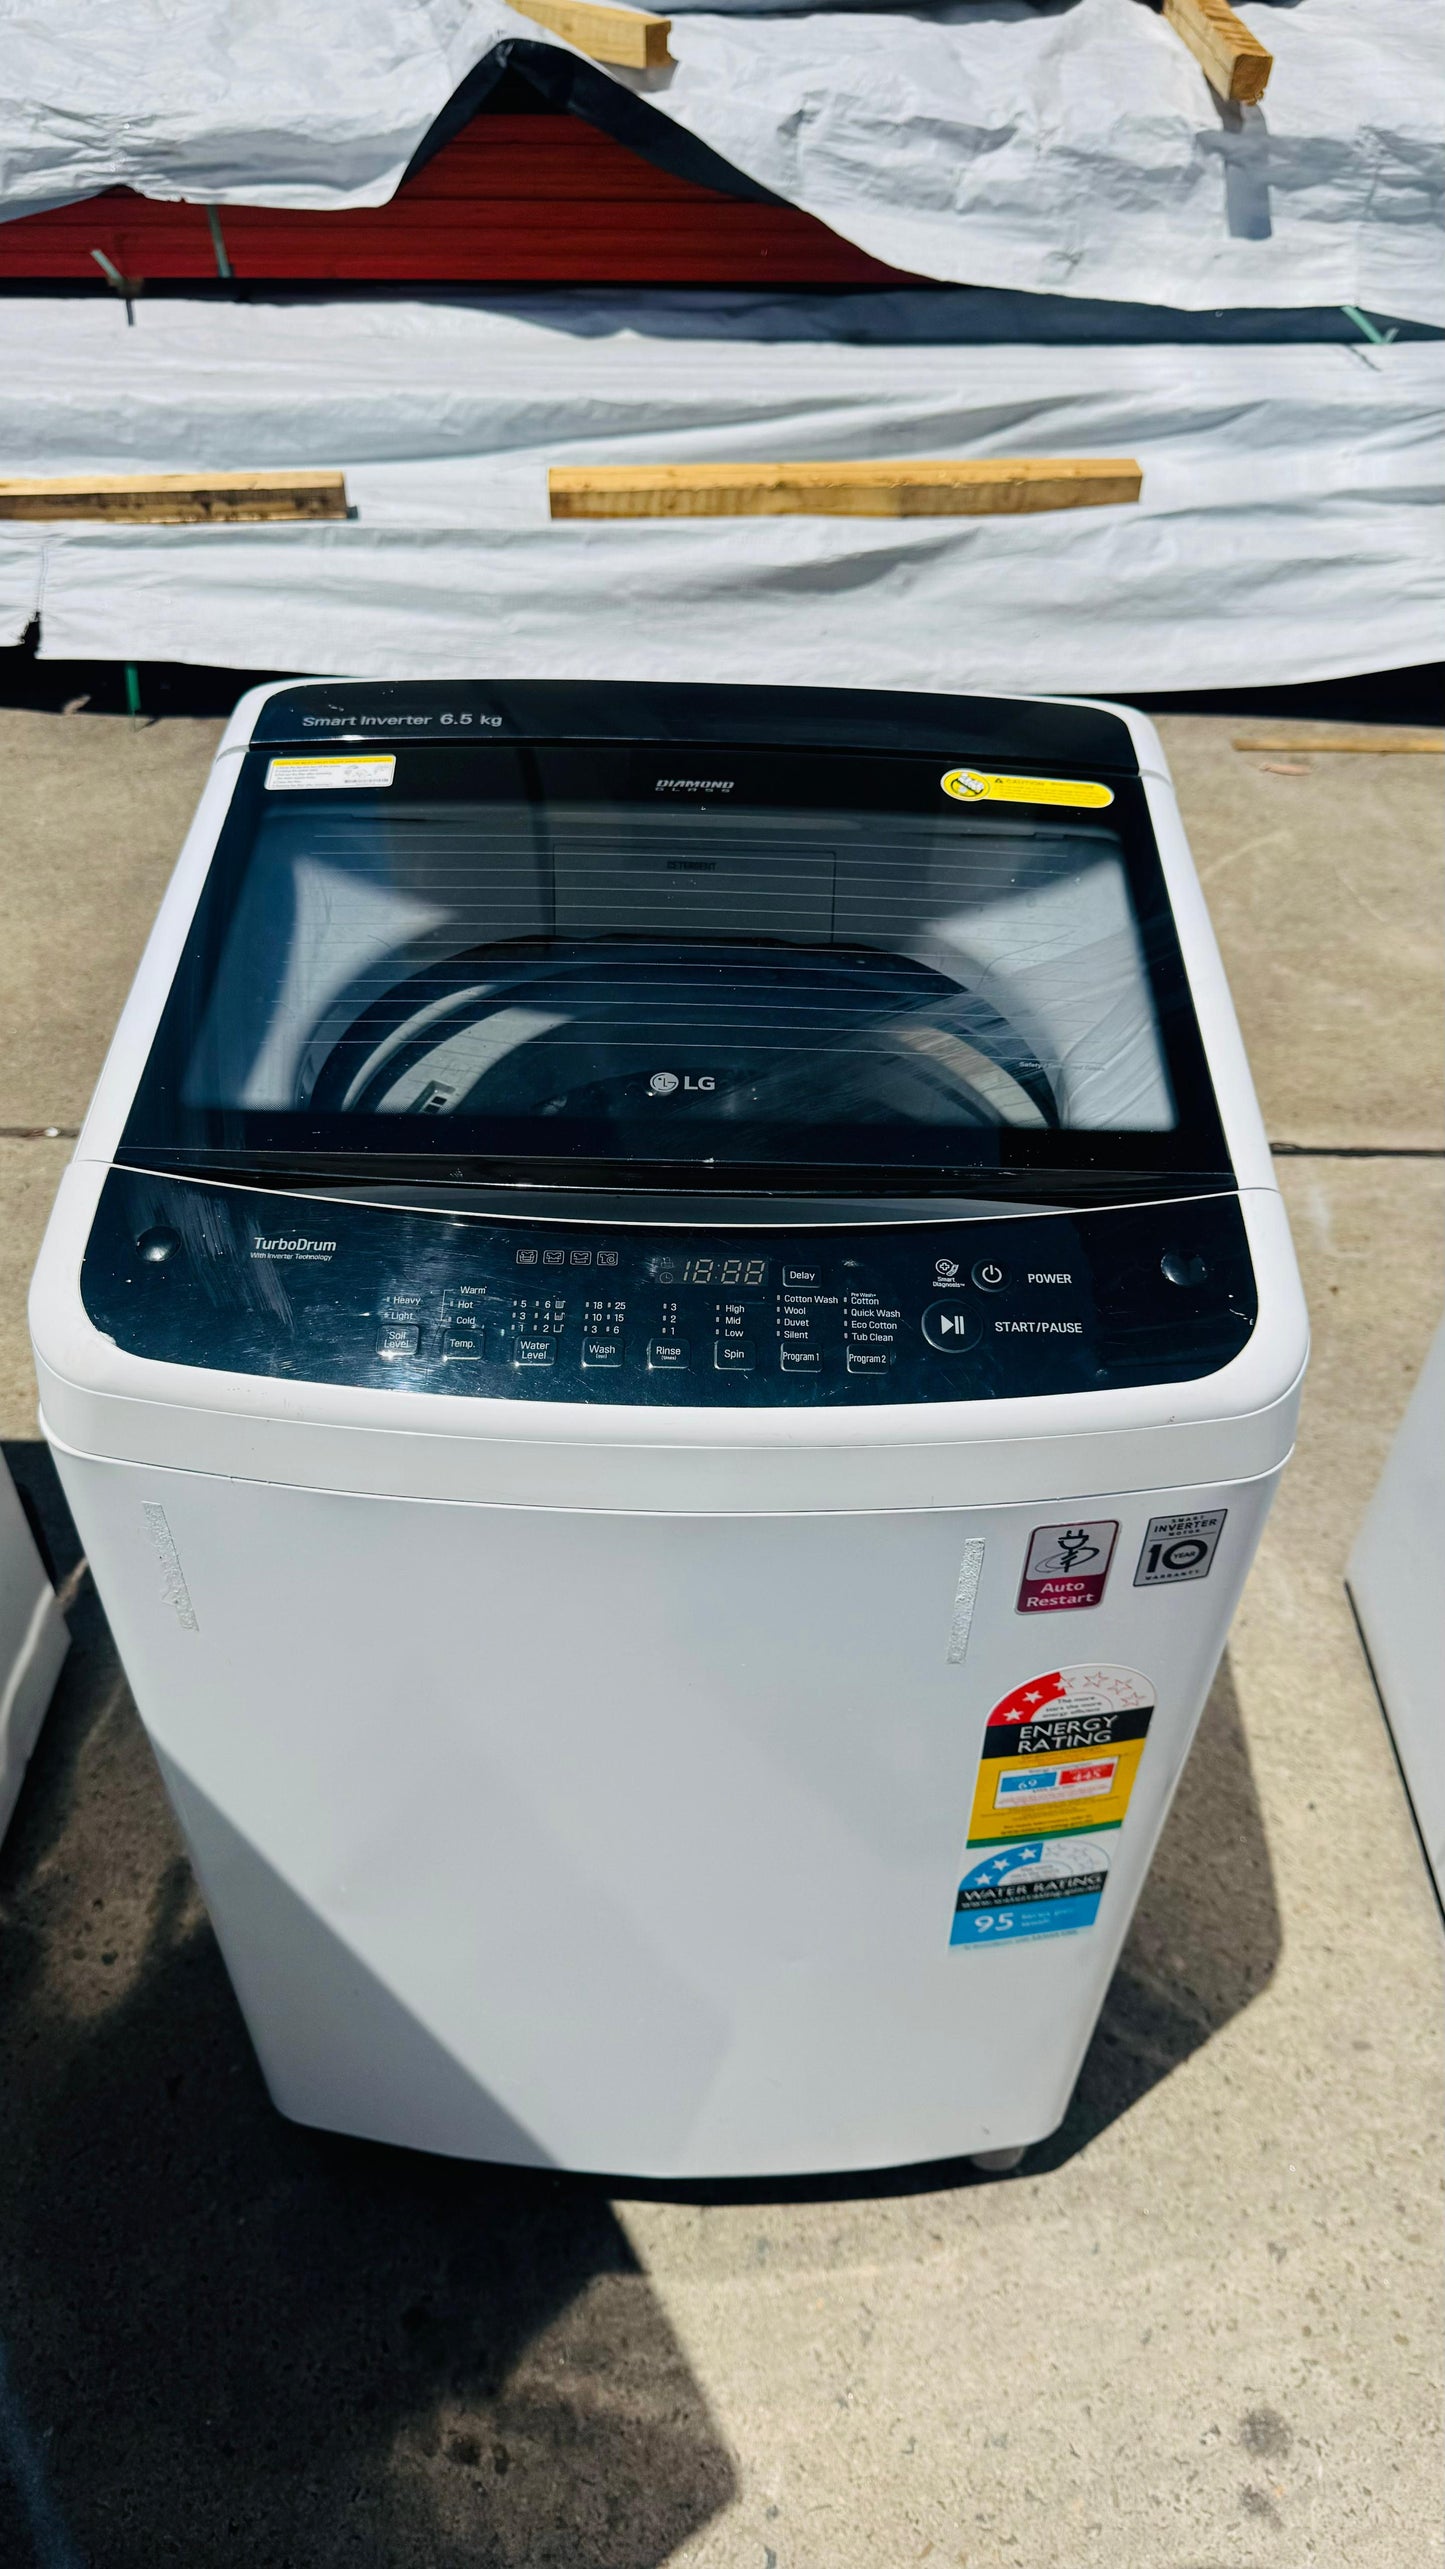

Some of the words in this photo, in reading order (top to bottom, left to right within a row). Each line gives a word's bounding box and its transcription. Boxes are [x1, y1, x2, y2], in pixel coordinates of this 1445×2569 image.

[302, 715, 356, 727] Smart
[360, 715, 432, 726] Inverter
[440, 713, 473, 725] 6.5
[480, 715, 503, 727] kg
[656, 779, 735, 789] DIAMOND
[684, 1076, 716, 1090] LG
[253, 1237, 337, 1251] TurboDrum
[267, 1252, 293, 1260] Inverter
[295, 1253, 333, 1261] Technology
[683, 1258, 766, 1285] 18:88
[789, 1270, 816, 1281] Delay
[1027, 1273, 1072, 1284] POWER
[393, 1296, 421, 1305] Heavy
[520, 1300, 527, 1308] 5
[784, 1294, 814, 1303] Cotton
[814, 1296, 839, 1304] Wash
[851, 1297, 879, 1305] Cotton
[458, 1301, 474, 1309] Hot
[593, 1301, 603, 1310] 18
[614, 1302, 626, 1310] 25
[670, 1303, 677, 1311] 3
[725, 1305, 745, 1314] High
[784, 1306, 806, 1315] Wool
[851, 1308, 875, 1318] Quick
[875, 1309, 901, 1318] Wash
[391, 1311, 413, 1321] Light
[456, 1316, 476, 1325] Cold
[520, 1312, 526, 1320] 3
[593, 1313, 603, 1322] 10
[614, 1313, 625, 1322] 15
[670, 1315, 677, 1323] 2
[725, 1316, 741, 1325] Mid
[784, 1318, 809, 1327] Duvet
[851, 1320, 868, 1329] Eco
[868, 1321, 898, 1330] Cotton
[994, 1321, 1083, 1333] START/PAUSE
[542, 1325, 549, 1333] 2
[591, 1325, 598, 1334] 3
[613, 1326, 620, 1334] 6
[725, 1329, 744, 1337] Low
[784, 1330, 808, 1339] Silent
[851, 1332, 868, 1341] Tub
[869, 1333, 894, 1342] Clean
[450, 1339, 476, 1349] Temp.
[520, 1341, 550, 1350] Water
[521, 1350, 547, 1359] Level
[589, 1345, 616, 1354] Wash
[656, 1346, 681, 1356] Rinse
[724, 1349, 745, 1359] Spin
[782, 1352, 815, 1362] Program
[849, 1354, 881, 1365] Program
[881, 1355, 887, 1363] 2
[1154, 1518, 1218, 1533] INVERTER
[1146, 1539, 1209, 1574] 10
[1173, 1550, 1196, 1560] YEAR
[1040, 1582, 1085, 1594] Auto
[1026, 1593, 1095, 1608] Restart
[1020, 1714, 1118, 1739] ENERGY
[1017, 1730, 1112, 1753] RATING
[964, 1885, 1028, 1902] WATER
[1033, 1875, 1101, 1893] RATING
[974, 1911, 1015, 1933] 95
